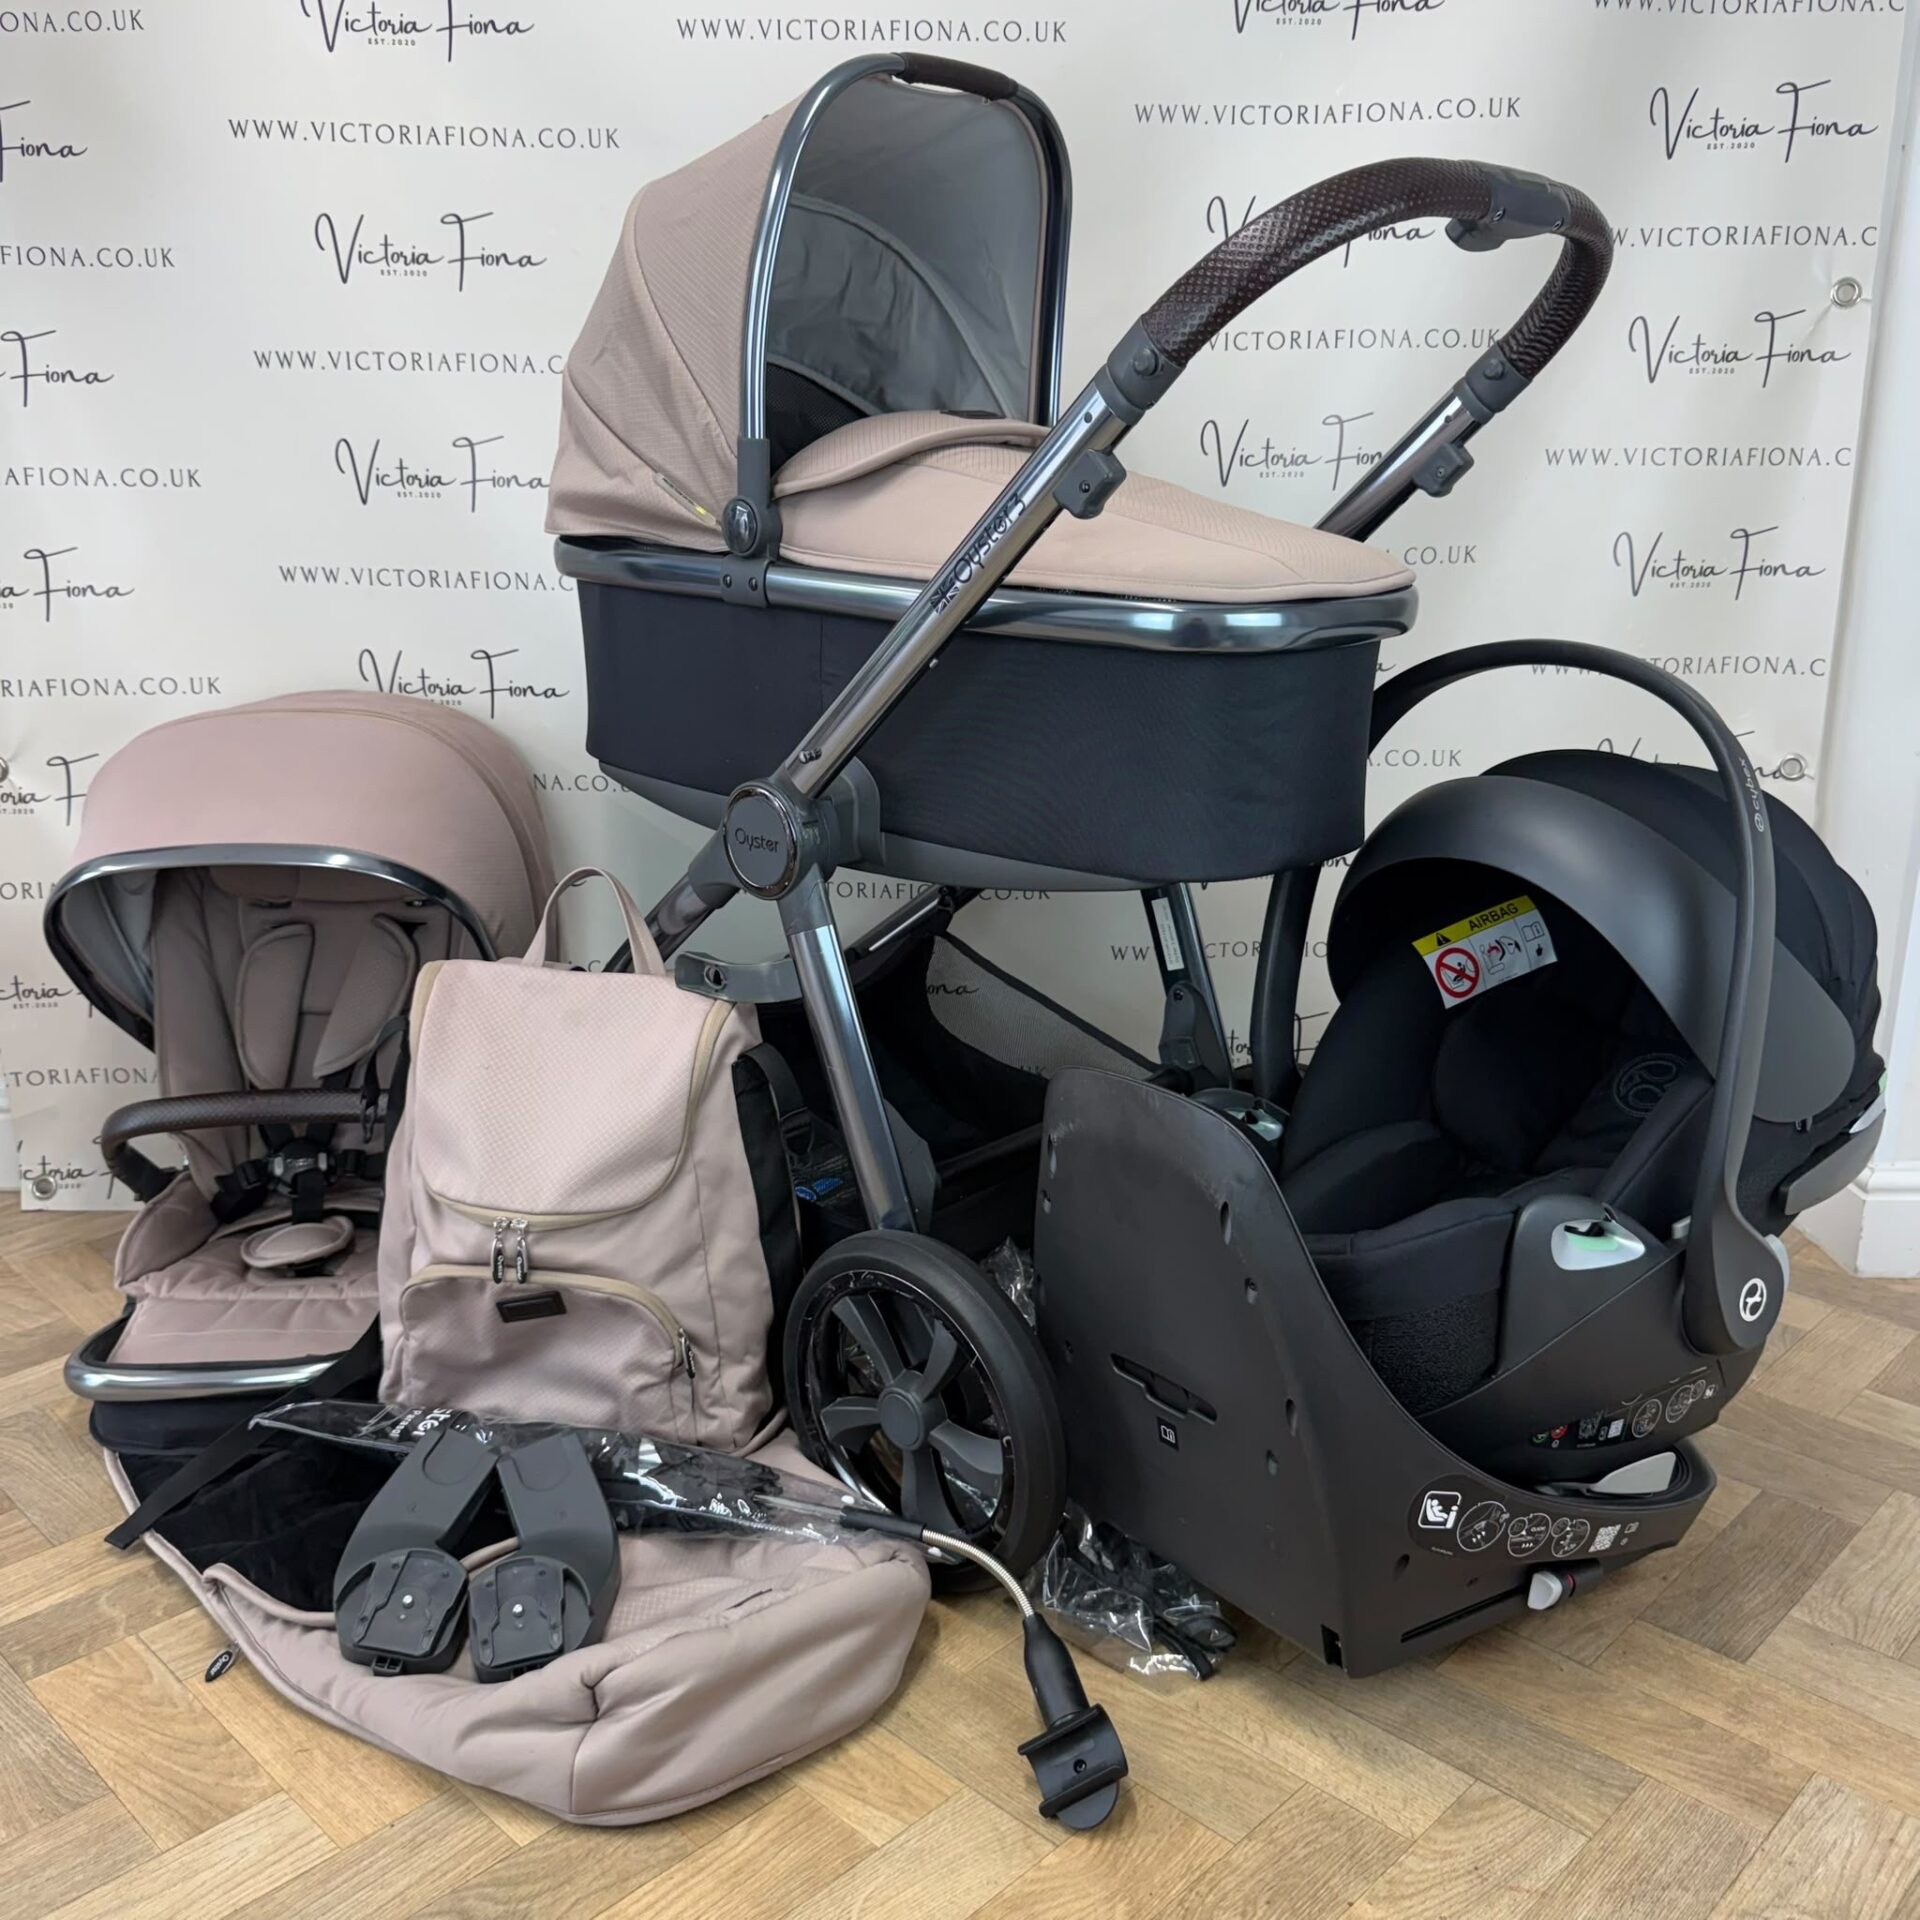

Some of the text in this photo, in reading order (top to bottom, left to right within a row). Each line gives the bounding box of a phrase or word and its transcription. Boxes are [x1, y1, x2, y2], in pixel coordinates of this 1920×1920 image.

[677, 18, 1066, 43] WWW.VICTORIAFIONA.CO.UK
[228, 119, 620, 149] WWW.VICTORIAFIONA.CO.UK
[1135, 97, 1521, 126] WWW.VICTORIAFIONA.CO.UK
[1650, 79, 1879, 163] Victoria Fiona
[314, 212, 547, 292] Victoria Fiona
[0, 330, 114, 407] Fiona
[1628, 310, 1852, 388] Victoria Fiona
[4, 466, 201, 488] AFIONA.CO.UK
[335, 436, 550, 513] Victoria Fiona
[1200, 412, 1382, 491] Victoria Fion
[1545, 447, 1851, 467] WWW.VICTORIAFIONA.C
[24, 547, 135, 622] Fiona
[1613, 526, 1826, 600] Victoria Fiona
[0, 677, 221, 698] RIAFIONA.CO.UK
[358, 648, 570, 720] Victoria Fiona
[735, 827, 779, 853] Oyster
[1468, 903, 1519, 932] AIRBAG
